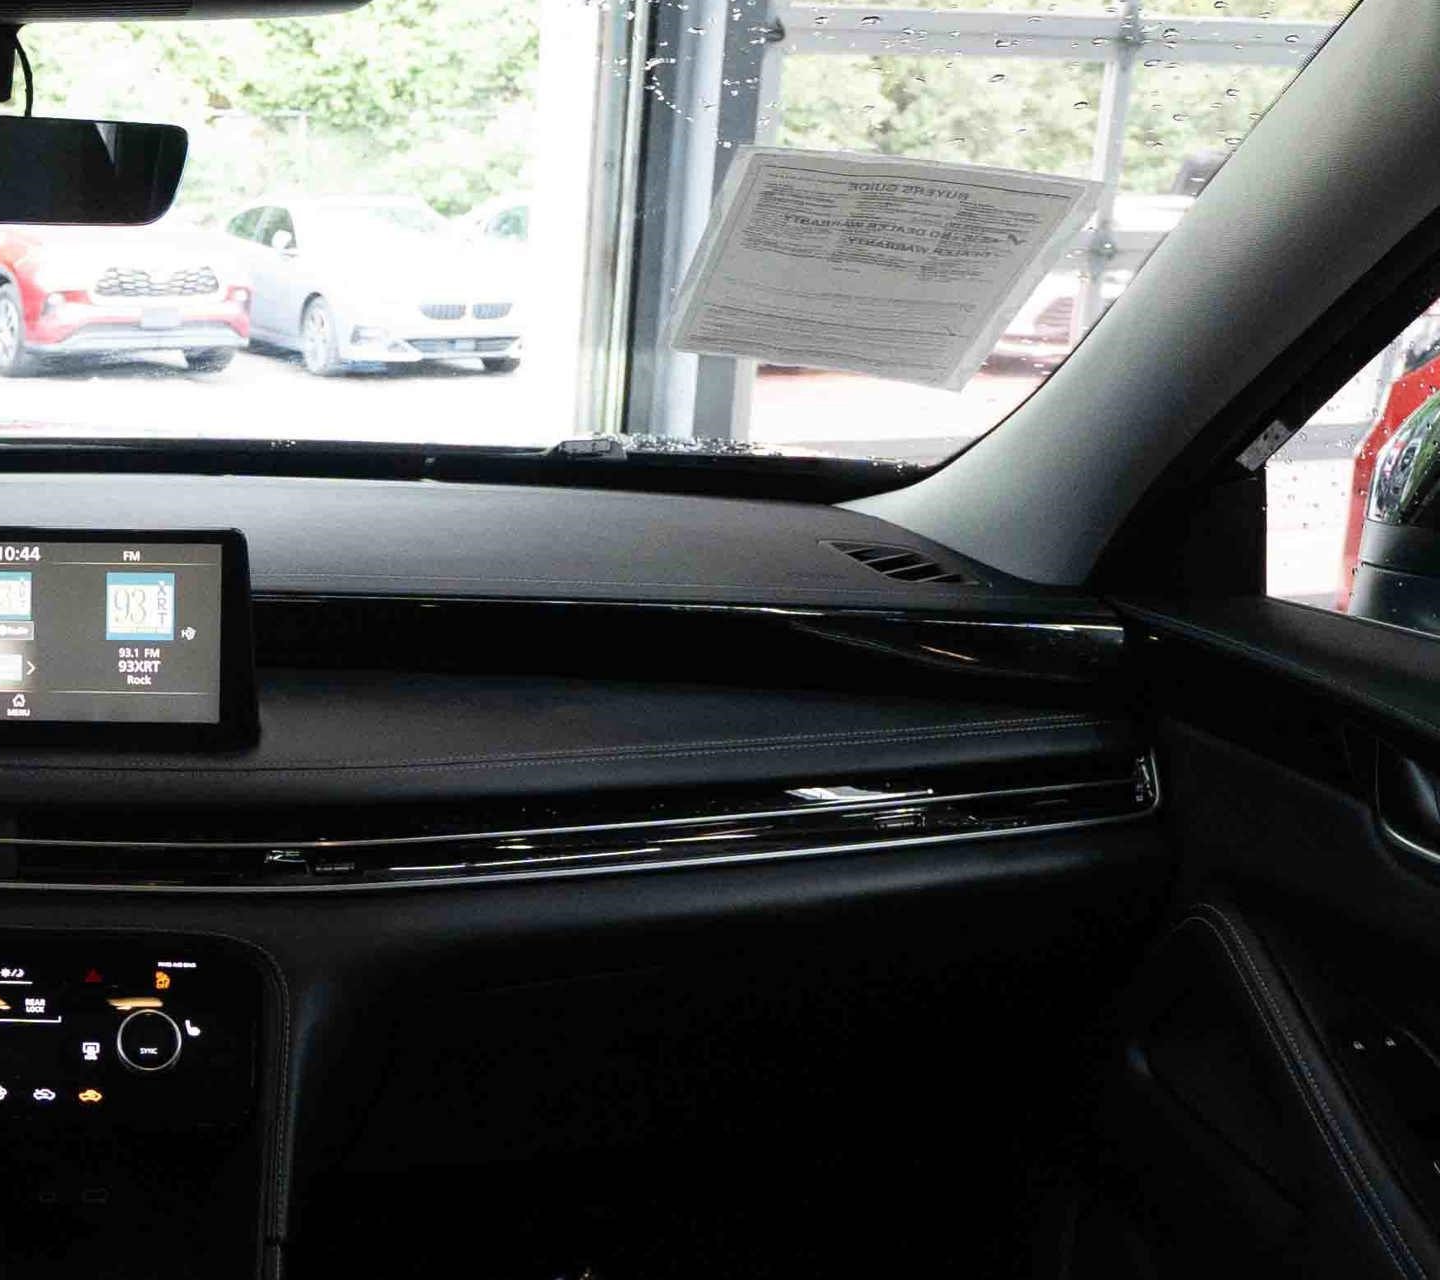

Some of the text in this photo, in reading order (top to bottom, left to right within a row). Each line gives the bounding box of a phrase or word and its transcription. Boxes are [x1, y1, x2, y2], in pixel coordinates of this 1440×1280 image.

[122, 551, 141, 561] FM
[113, 587, 148, 624] 93
[118, 648, 161, 659] 93.1 FM
[118, 660, 161, 673] 93XRT
[126, 675, 152, 685] Rock
[24, 998, 46, 1007] REAR
[25, 1006, 45, 1014] LOCK
